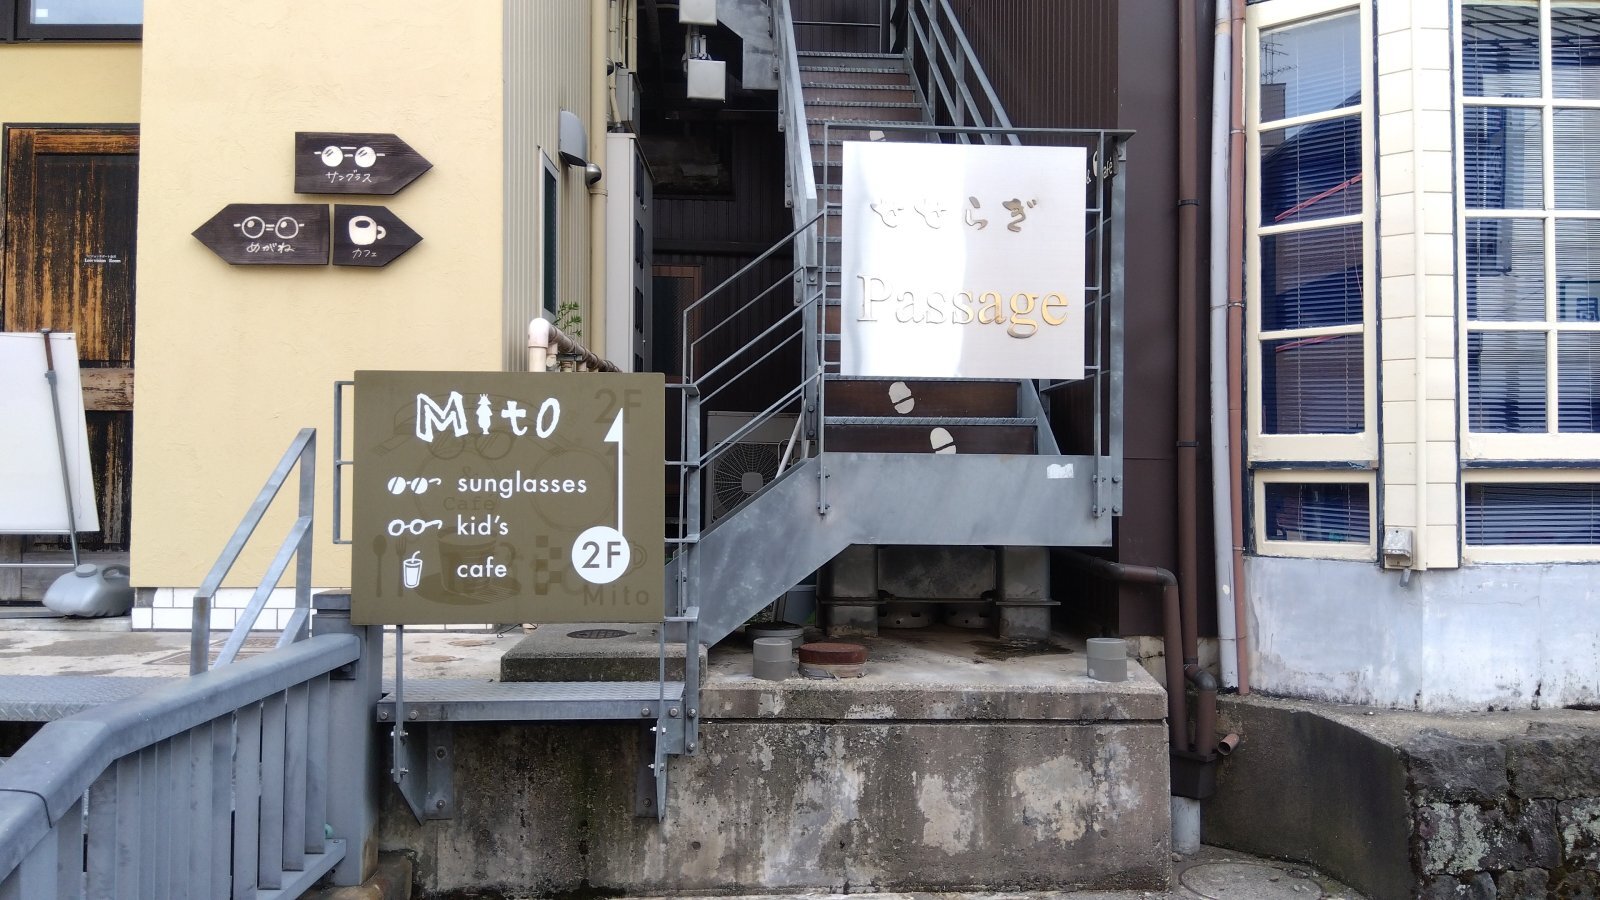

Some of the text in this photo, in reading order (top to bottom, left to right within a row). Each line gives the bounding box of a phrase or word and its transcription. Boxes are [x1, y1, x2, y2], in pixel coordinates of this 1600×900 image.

[325, 169, 372, 183] サングラス
[870, 196, 1039, 233] せせらぎ
[246, 242, 296, 254] めがね
[352, 248, 378, 260] カフェ
[857, 274, 1069, 339] Passage
[594, 388, 642, 424] 2F
[456, 470, 588, 499] sunglasses
[456, 514, 509, 536] kid's
[581, 541, 622, 569] 2F
[456, 556, 508, 578] cafe
[583, 584, 650, 606] Mito
